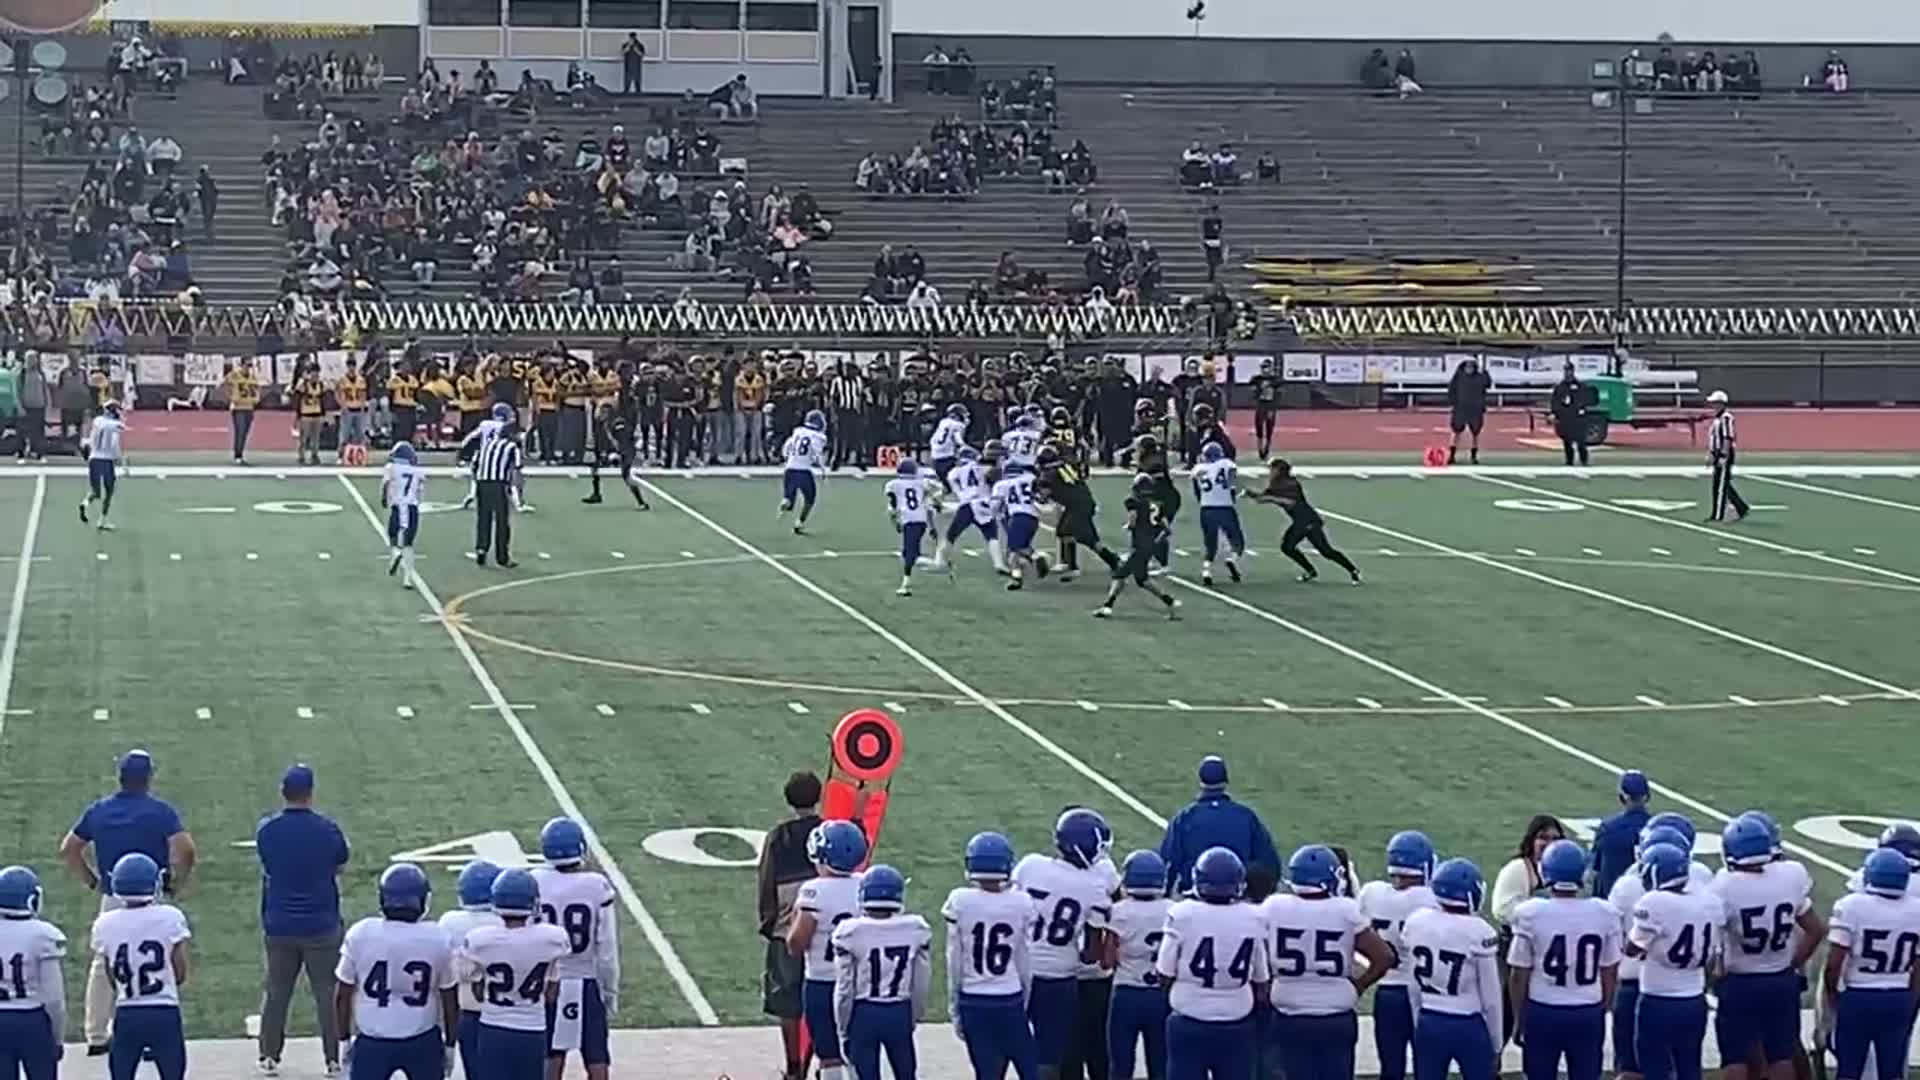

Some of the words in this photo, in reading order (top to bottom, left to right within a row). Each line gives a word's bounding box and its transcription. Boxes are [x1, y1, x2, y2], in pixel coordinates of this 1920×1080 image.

[402, 473, 413, 496] 7
[905, 488, 918, 511] 8
[114, 940, 165, 998] 42
[972, 921, 1014, 976] 16
[1189, 936, 1254, 988] 44
[1277, 927, 1345, 977] 55
[1543, 933, 1603, 987] 40
[1668, 922, 1711, 968] 41
[1858, 929, 1920, 974] 50
[364, 960, 432, 1007] 43
[487, 962, 549, 1007] 24
[869, 945, 911, 998] 17
[1412, 945, 1467, 996] 27
